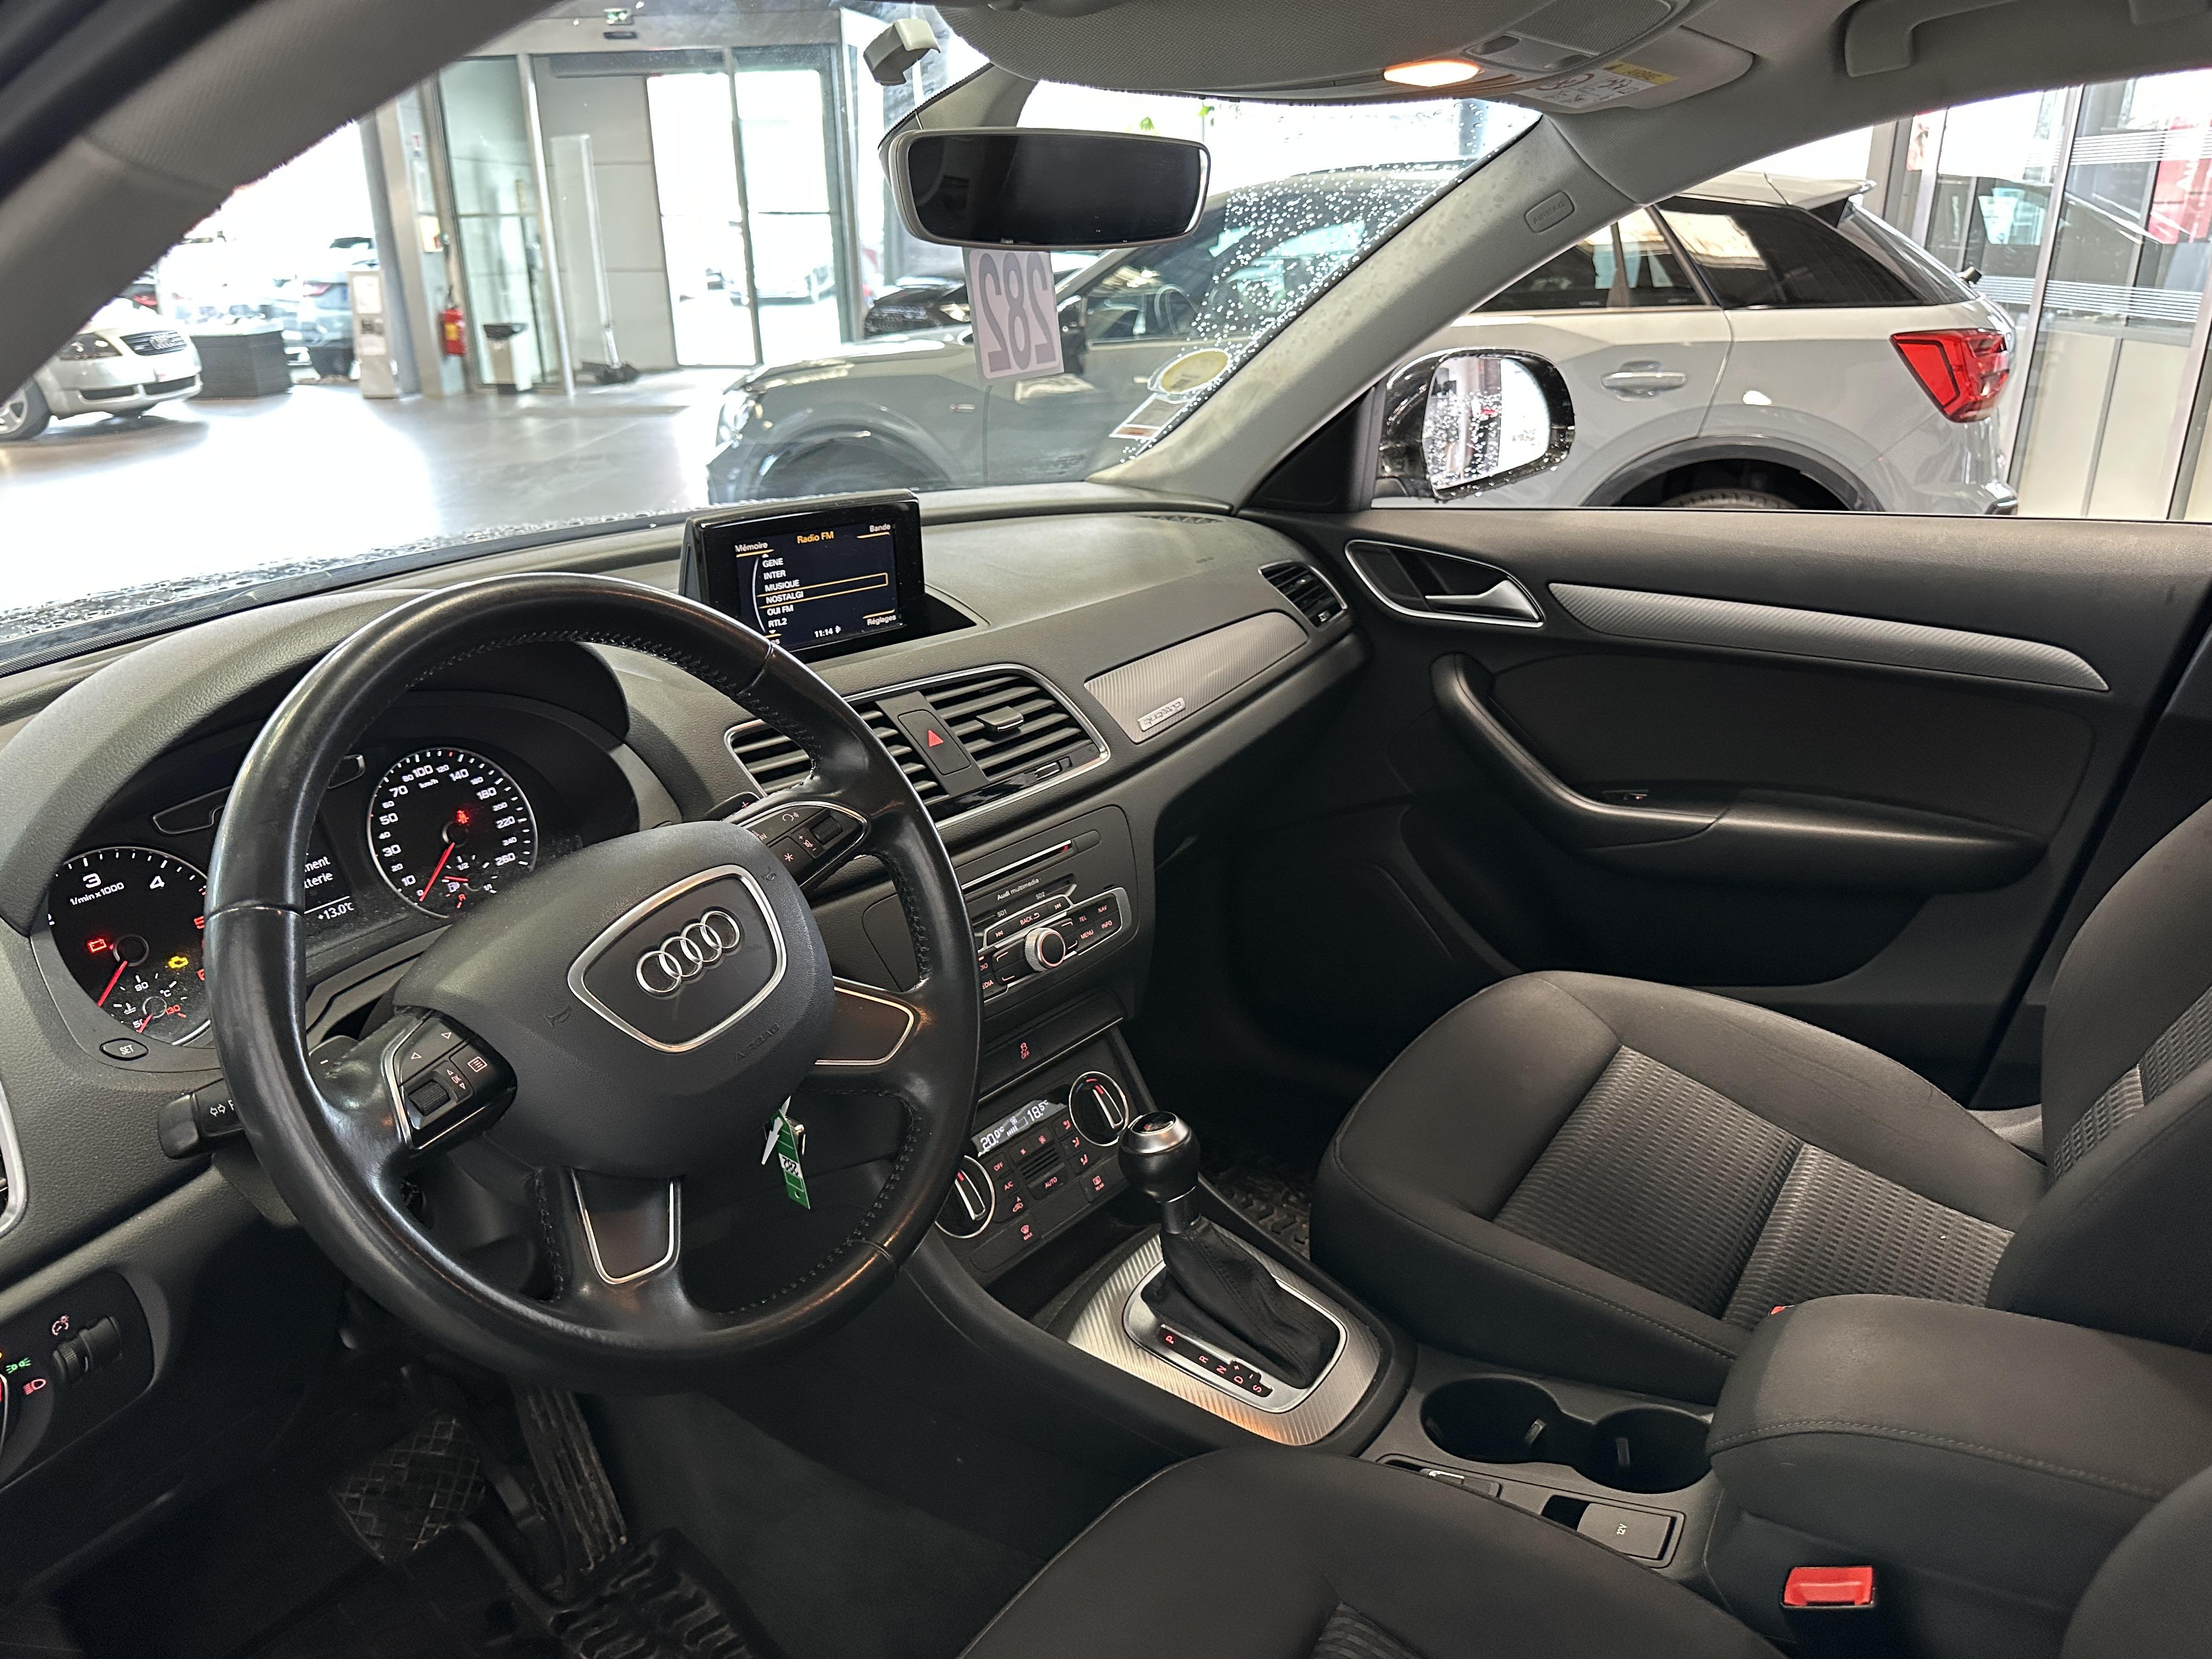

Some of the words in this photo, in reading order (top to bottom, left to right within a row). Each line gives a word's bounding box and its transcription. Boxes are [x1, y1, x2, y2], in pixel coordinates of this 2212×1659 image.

[1532, 201, 1566, 224] AIRBAG
[869, 523, 891, 532] Bande
[797, 534, 819, 544] Radio
[821, 531, 834, 541] FM
[735, 541, 768, 553] Mémoire
[762, 557, 784, 567] GENE
[763, 569, 786, 580] INTER
[764, 579, 800, 592] MUSIQUE
[765, 591, 804, 604] NOSTALGI
[767, 606, 781, 616] OUI
[782, 605, 794, 613] FM
[768, 618, 787, 628] RTL2
[867, 615, 896, 625] Réglages
[814, 628, 833, 638] 11:14
[412, 765, 433, 777] 100
[449, 769, 469, 781] 140
[418, 779, 438, 788] km/h
[388, 785, 408, 797] 70
[476, 787, 496, 800] 180
[492, 802, 507, 811] 200
[379, 812, 398, 825] 50
[495, 816, 515, 828] 220
[382, 844, 401, 856] 30
[494, 853, 516, 866] 260
[391, 864, 403, 872] 20
[82, 873, 101, 888] 3
[149, 876, 165, 889] 4
[304, 872, 334, 889] tterie
[401, 875, 415, 886] 10
[70, 894, 95, 905] 1/min
[100, 882, 125, 896] 1000
[997, 891, 1010, 901] Audi
[1011, 879, 1039, 894] multimedia
[1035, 891, 1046, 900] SD2
[996, 909, 1007, 918] SD1
[1098, 905, 1107, 913] NAV
[1019, 915, 1034, 926] BACK
[1101, 920, 1113, 929] INFO
[1080, 929, 1094, 940] MENU
[134, 981, 149, 992] 90
[983, 979, 994, 989] EDIA
[165, 1005, 181, 1015] 130
[120, 1045, 134, 1056] SET
[994, 1161, 1004, 1171] OFF
[1005, 1181, 1013, 1190] A/C
[1045, 1177, 1058, 1189] AUTO
[1165, 1335, 1175, 1345] P
[1199, 1355, 1209, 1363] R
[1216, 1365, 1227, 1374] N
[1234, 1375, 1244, 1385] D
[1252, 1385, 1262, 1393] S
[1616, 1523, 1628, 1535] 12V
